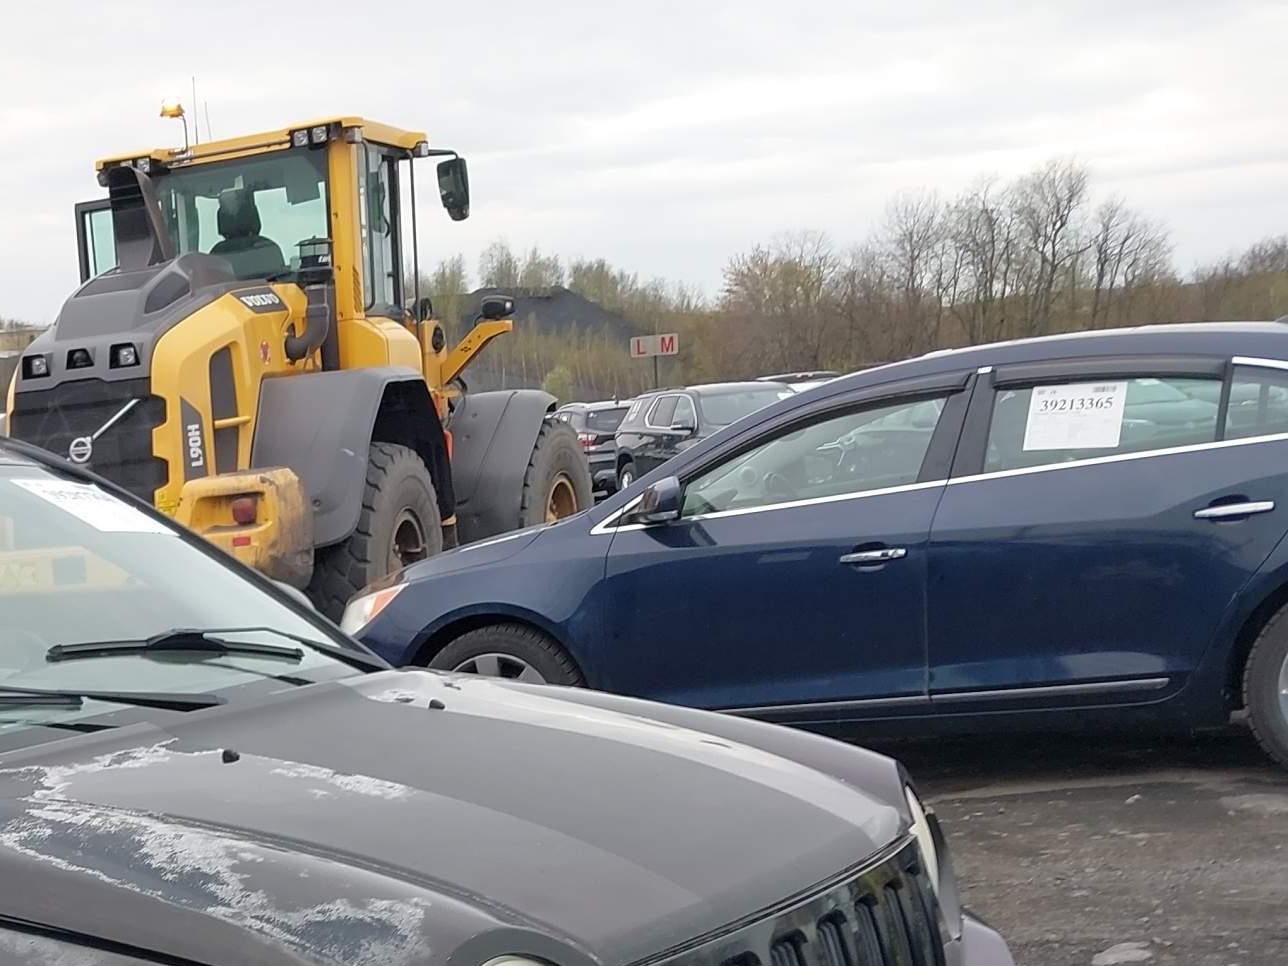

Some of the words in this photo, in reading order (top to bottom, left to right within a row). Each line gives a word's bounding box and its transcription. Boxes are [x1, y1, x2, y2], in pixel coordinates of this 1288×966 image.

[240, 293, 280, 307] VOLVO
[1039, 396, 1114, 412] 39213365
[187, 424, 203, 467] L90H
